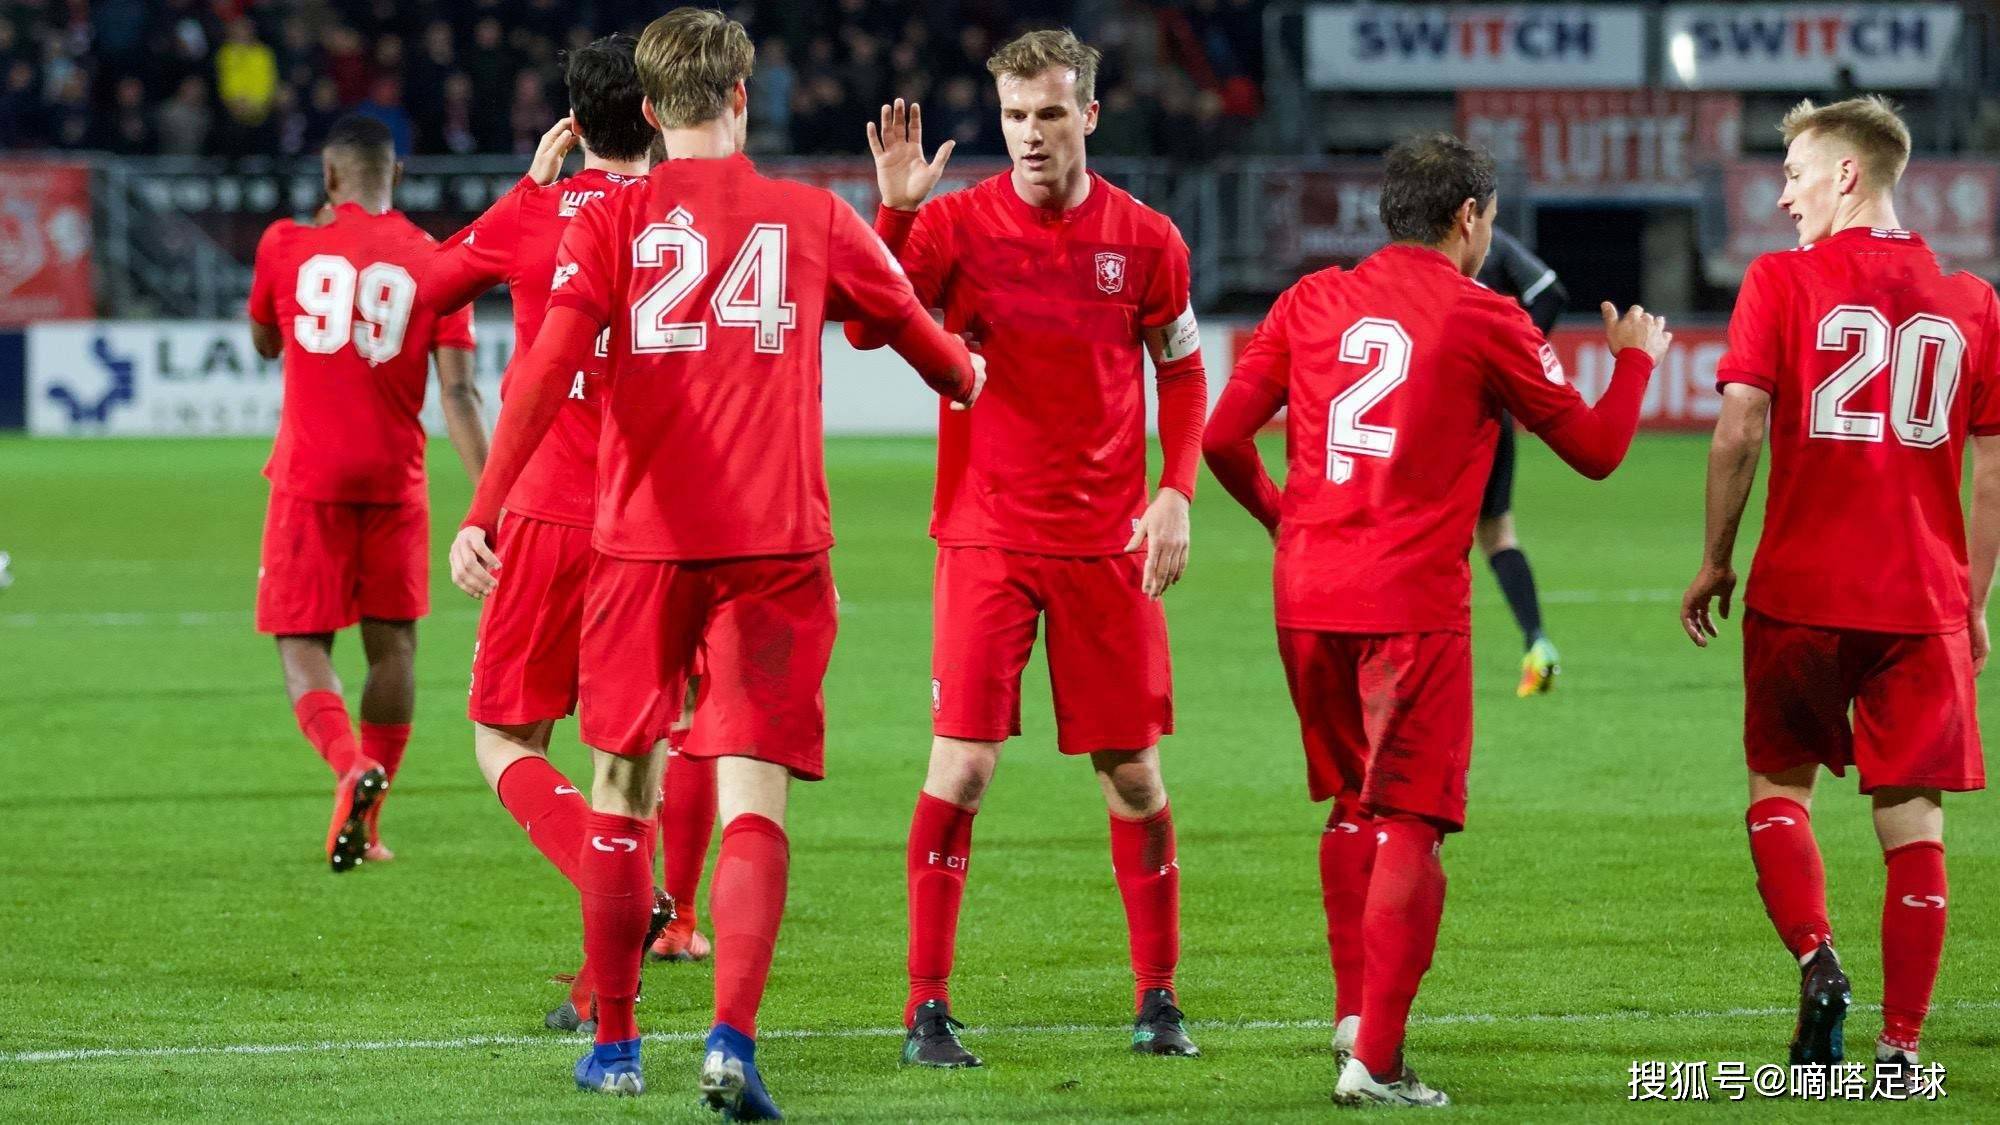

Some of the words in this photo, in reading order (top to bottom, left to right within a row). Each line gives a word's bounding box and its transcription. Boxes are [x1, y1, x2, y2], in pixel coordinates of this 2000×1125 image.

[1355, 15, 1595, 61] SWITCH
[1692, 14, 1930, 58] SWITCH
[1540, 114, 1691, 182] LUTTE
[294, 254, 417, 364] 99
[631, 222, 796, 354] 24
[1326, 316, 1414, 459] 2
[1809, 304, 1967, 449] 20
